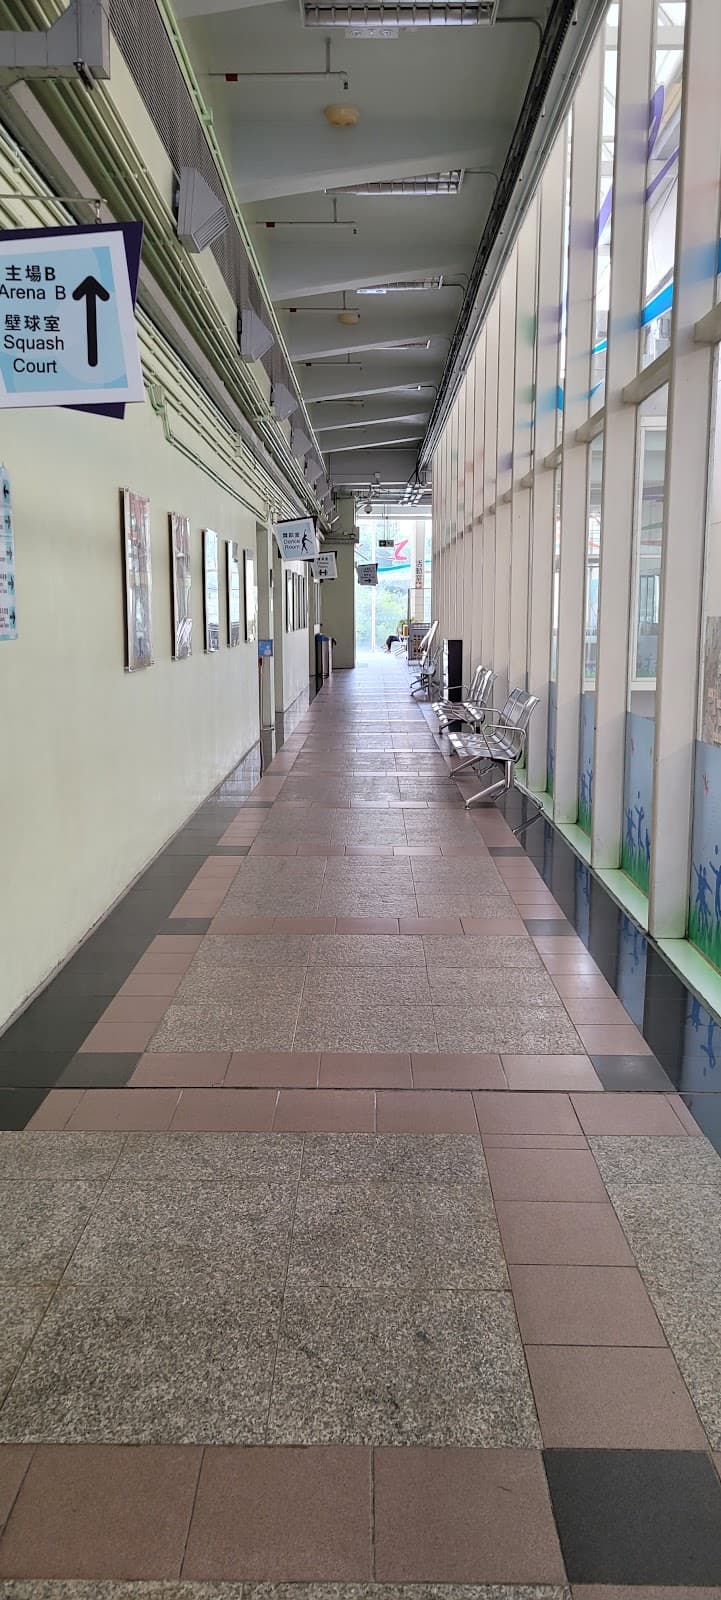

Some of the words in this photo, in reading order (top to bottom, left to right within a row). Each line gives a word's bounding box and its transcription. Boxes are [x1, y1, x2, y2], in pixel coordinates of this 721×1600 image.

[5, 265, 56, 283] 主場B
[0, 284, 46, 300] Arena
[56, 285, 67, 300] B
[4, 314, 61, 332] 壁球室
[4, 335, 65, 352] Squash
[13, 358, 58, 373] Court
